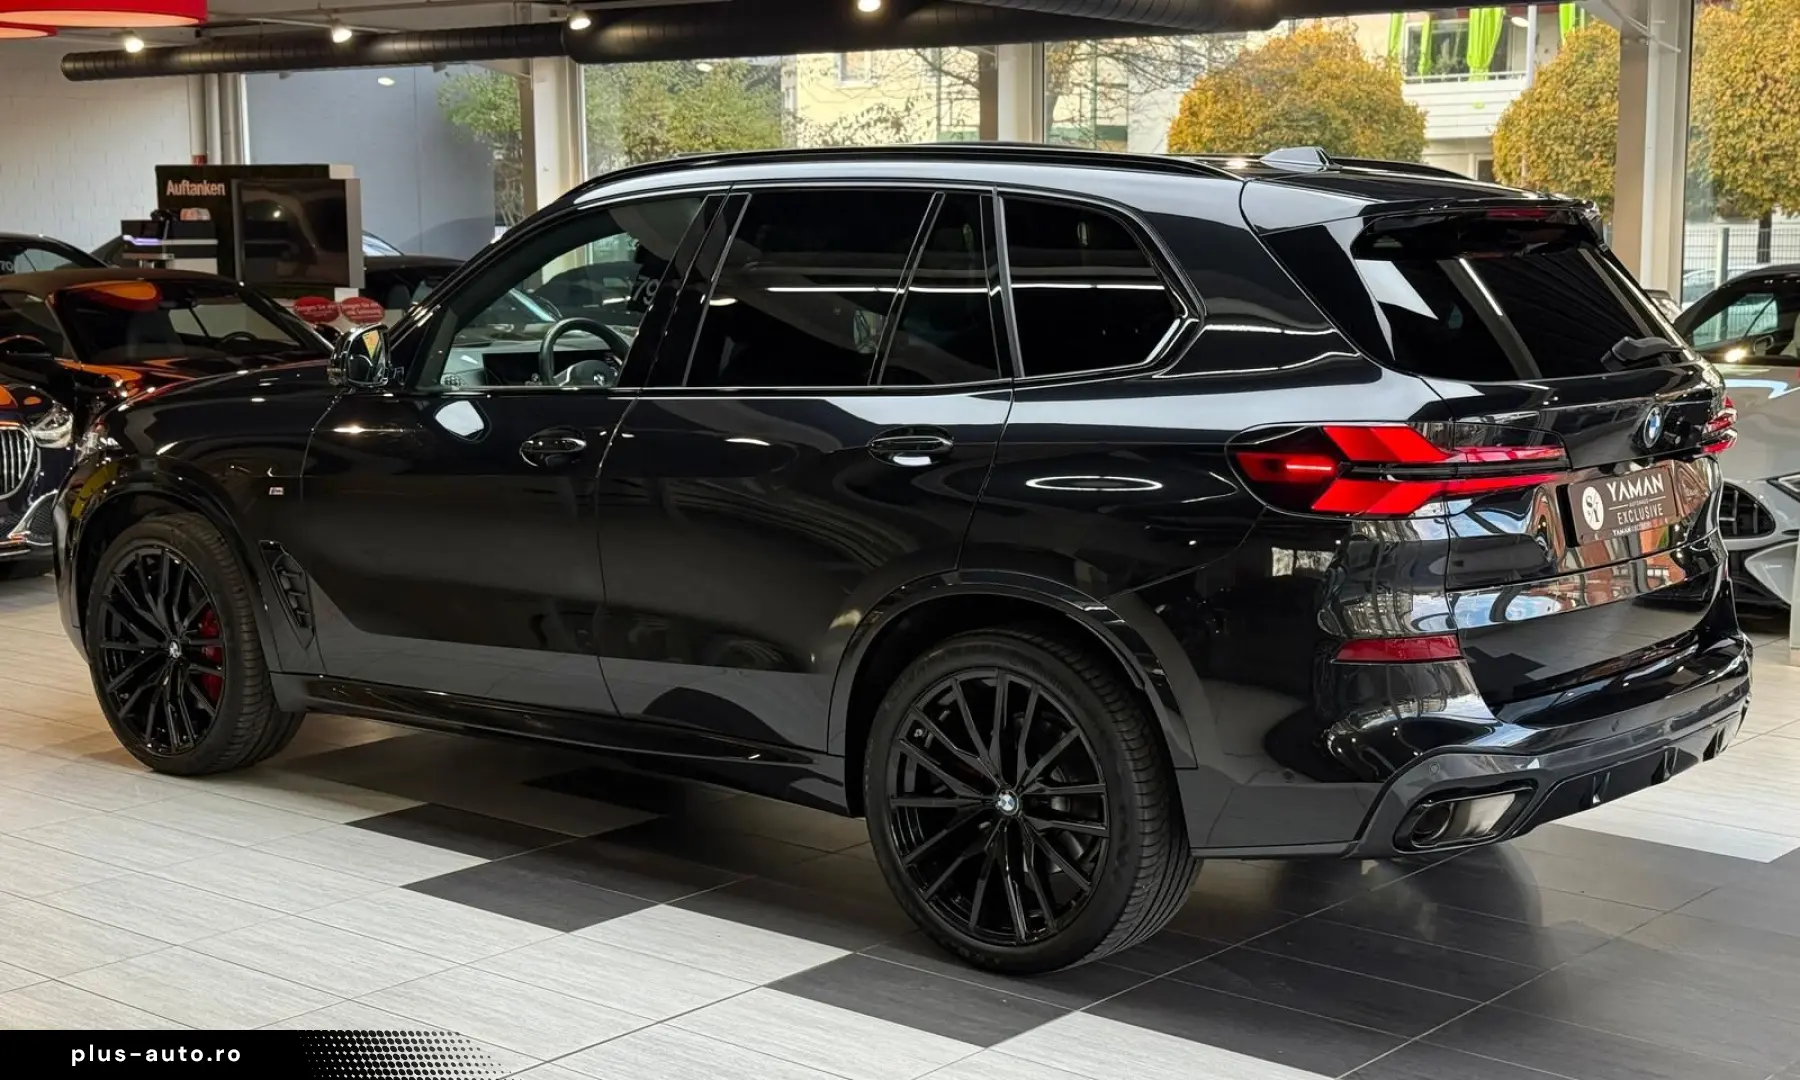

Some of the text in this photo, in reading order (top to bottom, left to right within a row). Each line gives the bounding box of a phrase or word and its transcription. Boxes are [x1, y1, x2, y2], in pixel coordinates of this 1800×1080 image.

[166, 179, 226, 197] Auftanken
[1606, 473, 1665, 502] YAMAN
[1617, 503, 1664, 525] EXCLUSIVE
